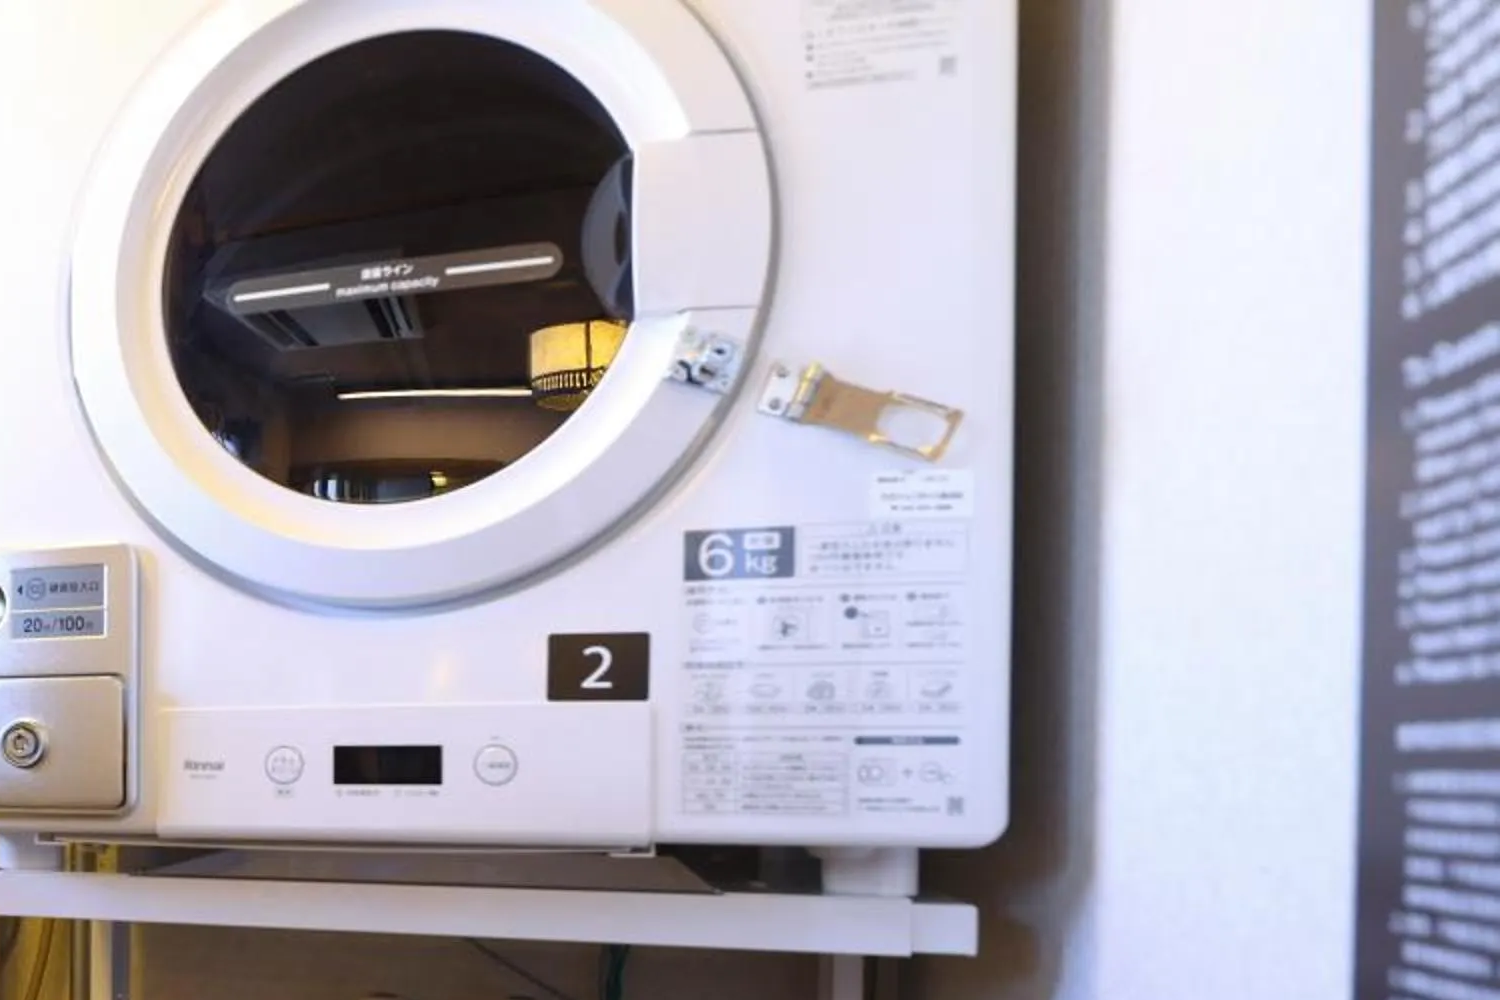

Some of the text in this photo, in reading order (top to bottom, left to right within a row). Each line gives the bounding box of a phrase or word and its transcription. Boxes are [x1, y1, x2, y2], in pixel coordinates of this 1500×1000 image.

[391, 276, 439, 291] capacity
[698, 533, 778, 577] 6 kg
[580, 646, 614, 689] 2
